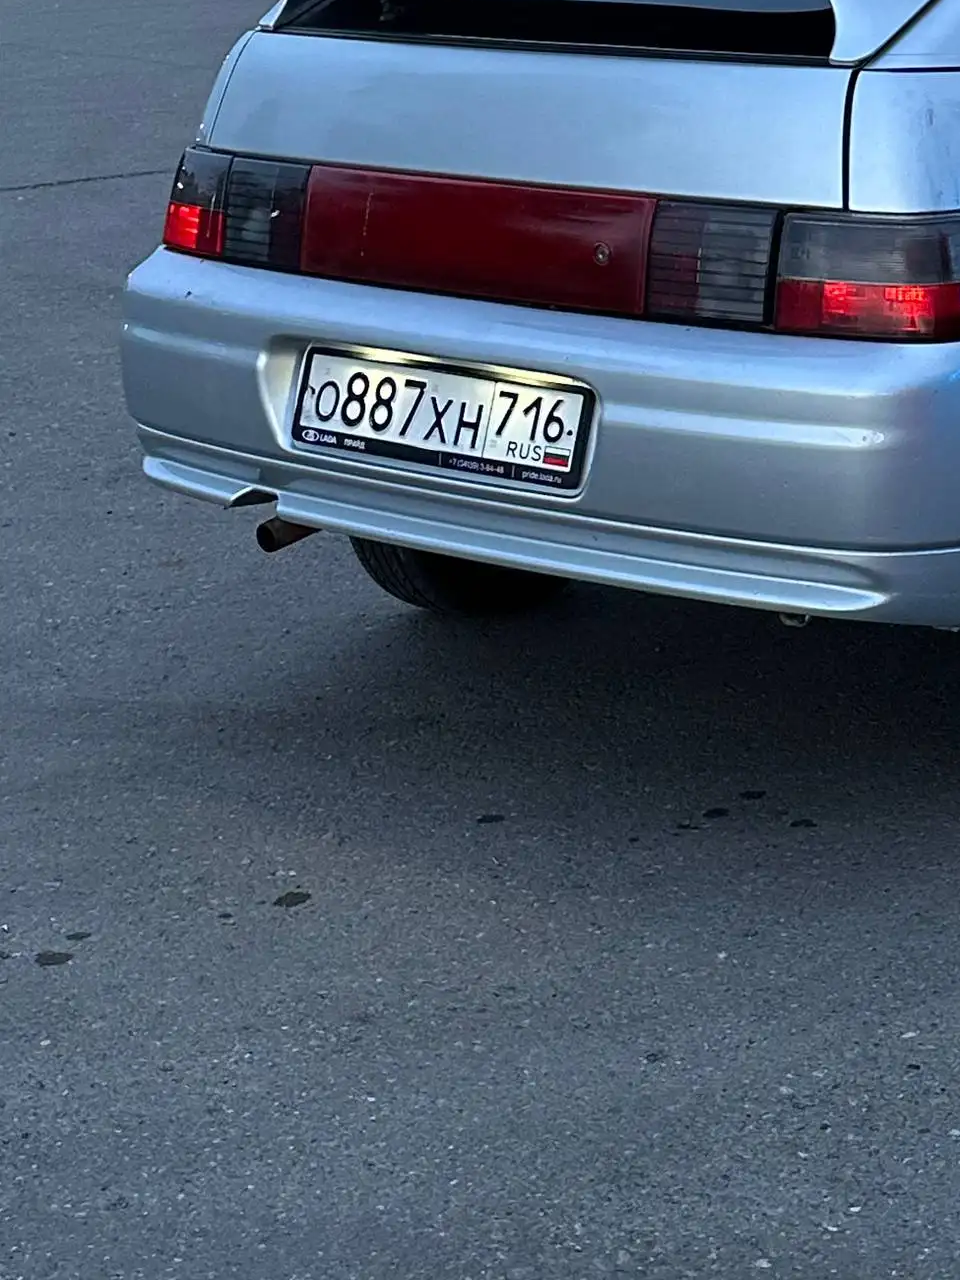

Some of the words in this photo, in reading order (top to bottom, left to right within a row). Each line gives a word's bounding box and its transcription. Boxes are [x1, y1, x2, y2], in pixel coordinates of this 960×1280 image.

[499, 391, 565, 443] 716
[319, 433, 337, 445] LADA
[506, 441, 542, 460] RUS
